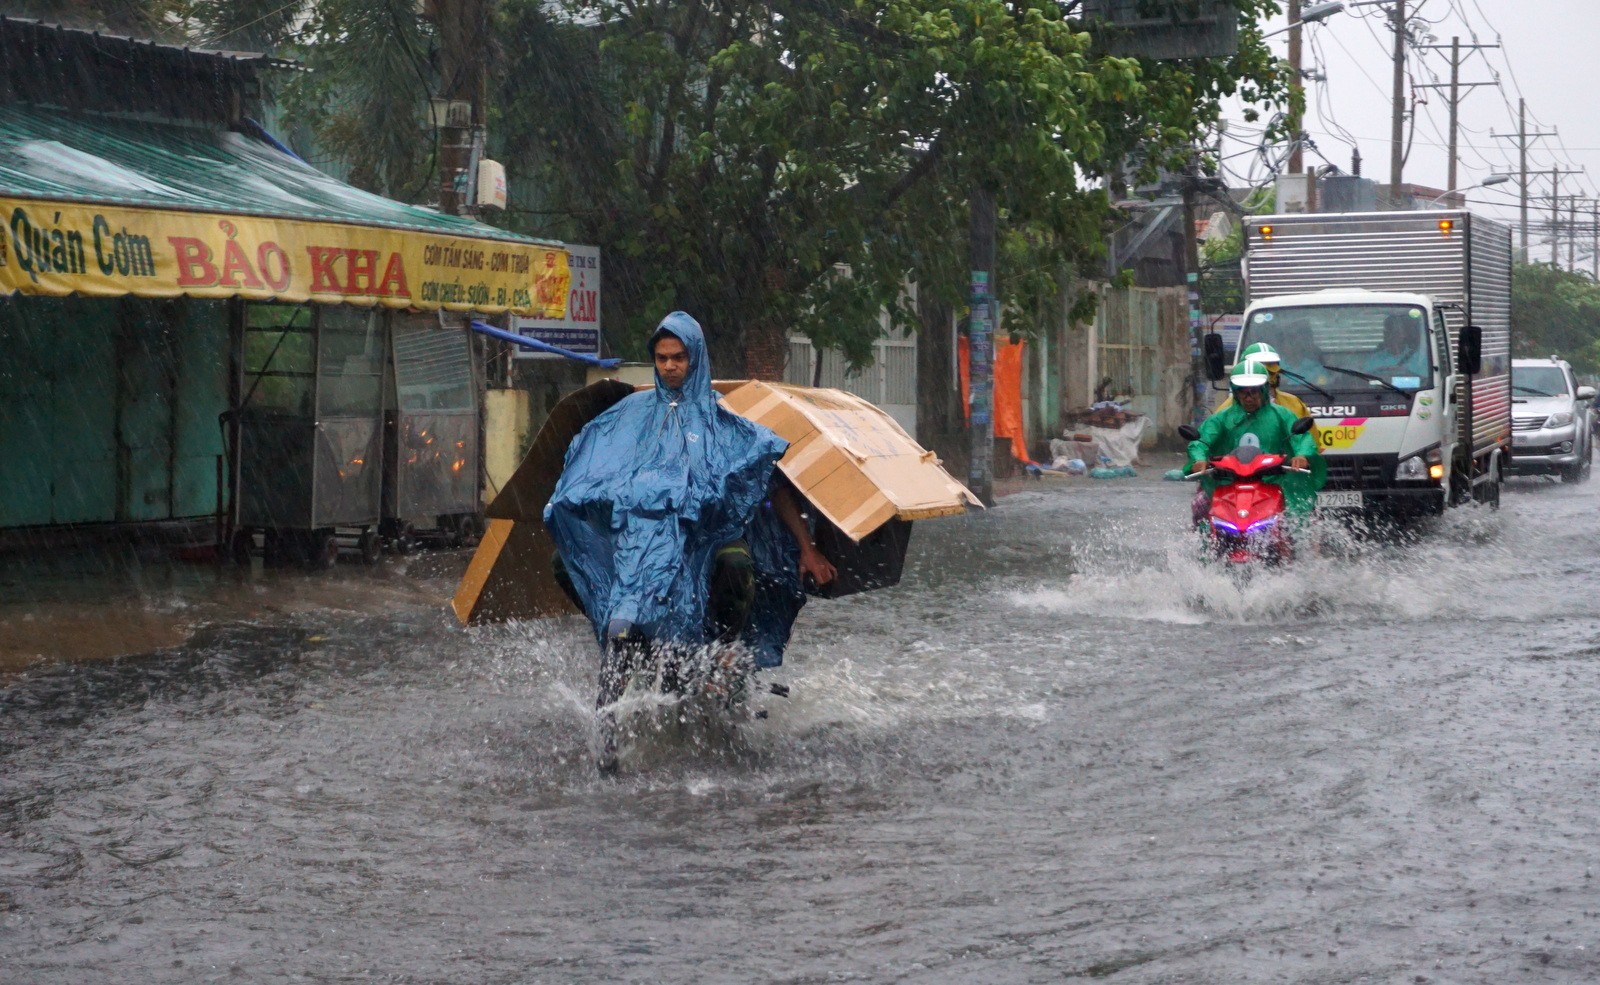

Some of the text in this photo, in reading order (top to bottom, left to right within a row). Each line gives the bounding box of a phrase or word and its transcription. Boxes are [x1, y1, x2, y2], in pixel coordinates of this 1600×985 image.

[11, 207, 87, 283] Quán
[93, 214, 156, 276] Cơm
[168, 220, 412, 299] BẢO KHA
